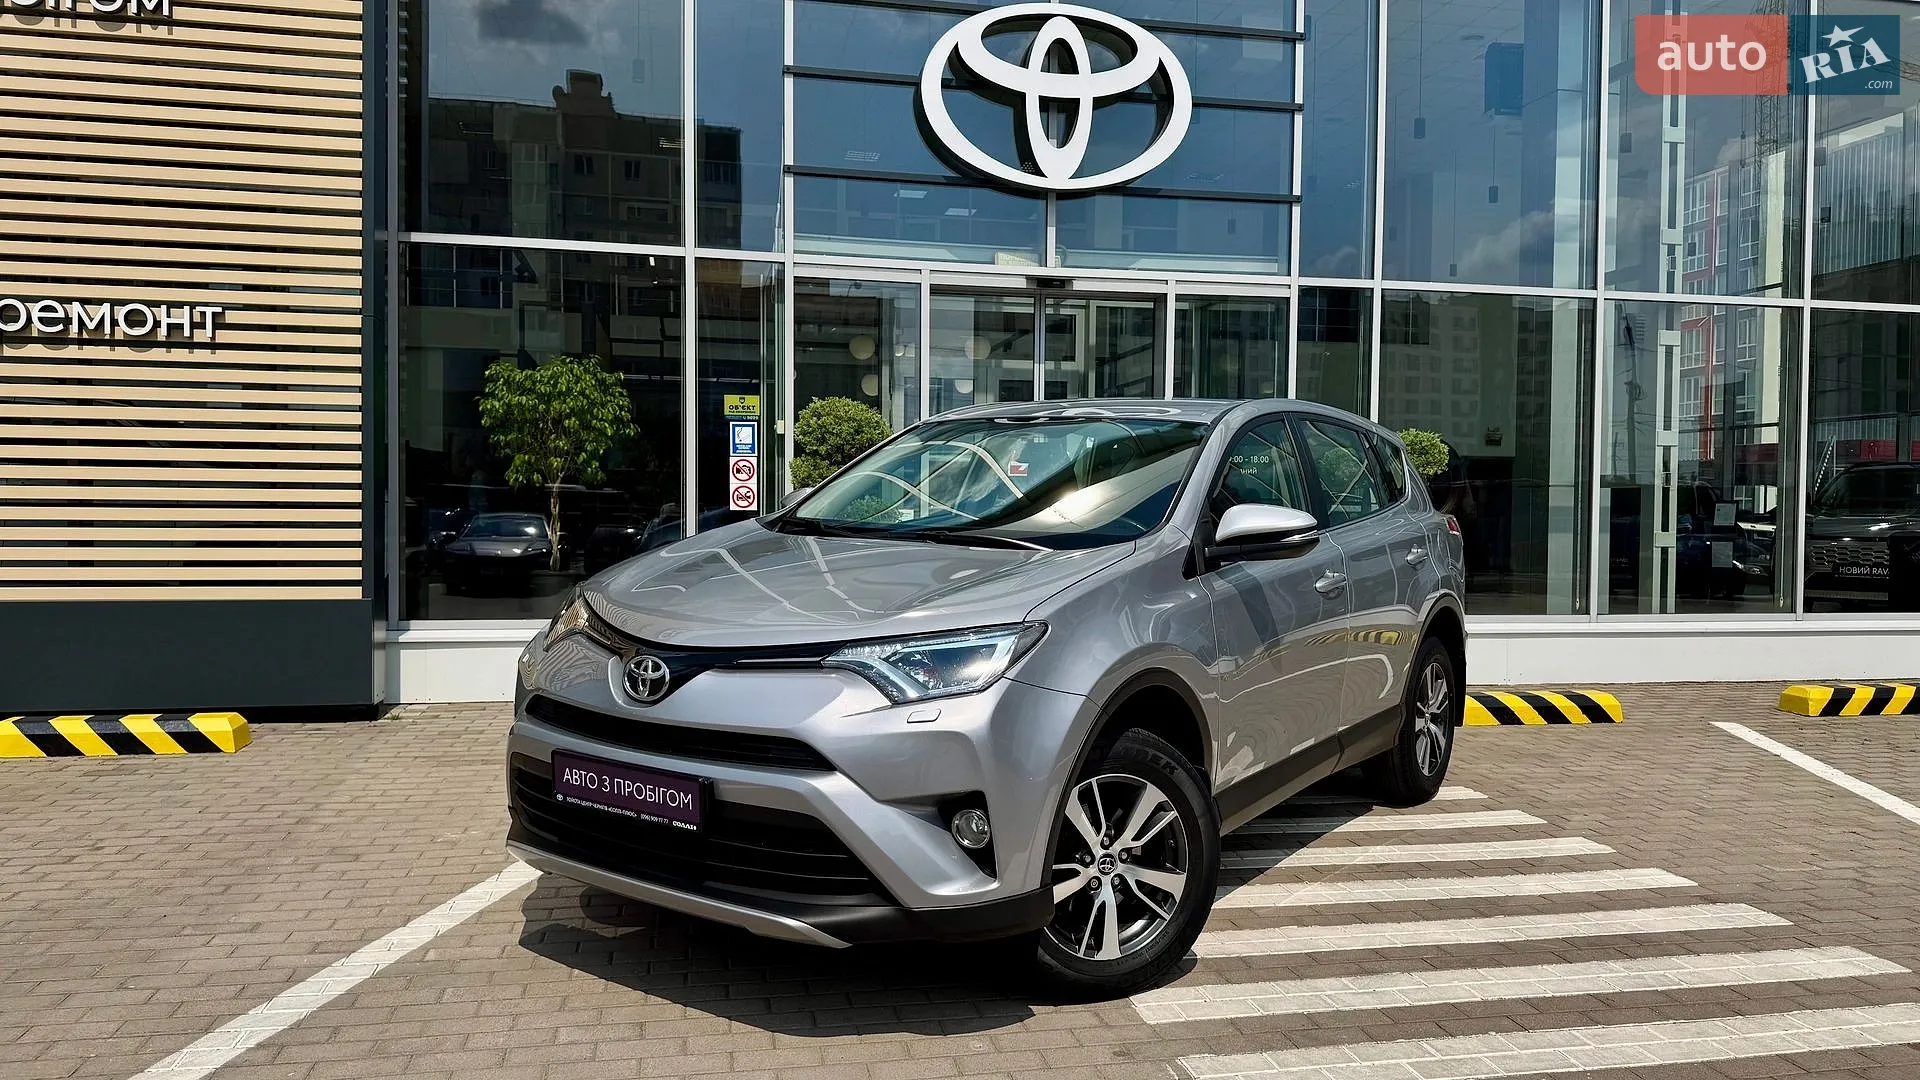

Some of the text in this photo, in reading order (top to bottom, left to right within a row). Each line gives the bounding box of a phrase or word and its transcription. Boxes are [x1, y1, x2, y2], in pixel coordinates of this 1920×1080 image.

[1839, 566, 1889, 575] НОВИЙ RAV
[563, 767, 598, 789] АВТО
[614, 778, 692, 810] ПРОБІГОМ
